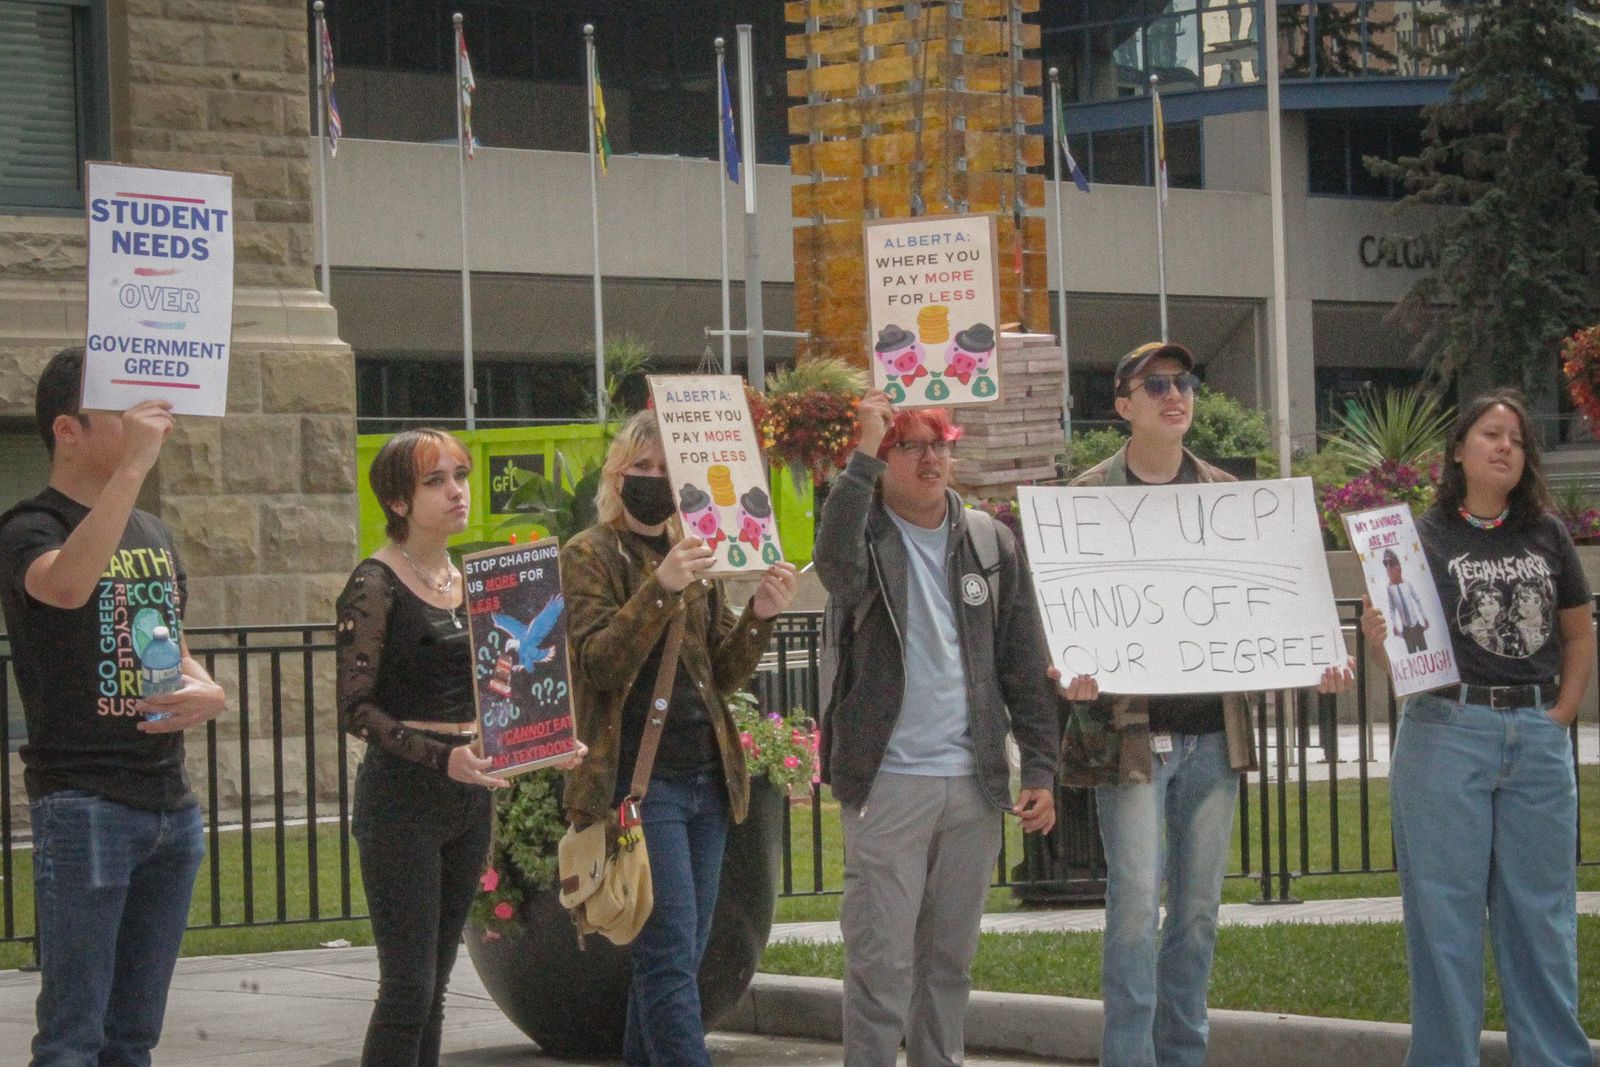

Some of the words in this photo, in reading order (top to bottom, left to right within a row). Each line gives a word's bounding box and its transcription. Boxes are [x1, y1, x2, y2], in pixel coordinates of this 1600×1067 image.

[90, 198, 228, 232] STUDENT
[112, 230, 209, 261] NEEDS
[884, 232, 970, 249] ALBERTA:
[876, 253, 939, 269] WHERE
[945, 250, 980, 263] YOU
[883, 274, 919, 287] PAY
[925, 270, 974, 284] MORE
[119, 284, 200, 313] OVER
[888, 293, 924, 306] FOR
[929, 289, 976, 303] LESS
[89, 334, 225, 360] GOVERNMENT
[124, 358, 189, 377] GREED
[666, 390, 731, 403] ALBERTA:
[663, 410, 712, 423] WHERE
[715, 410, 742, 422] YOU
[672, 431, 700, 443] PAY
[704, 430, 742, 442] MORE
[680, 452, 709, 464] FOR
[712, 450, 747, 463] LESS
[493, 475, 518, 492] GFL
[1032, 493, 1149, 556] HEY
[1175, 487, 1296, 546] UCP!
[1355, 521, 1368, 534] MY
[1369, 513, 1403, 530] SAVINGS
[1369, 534, 1382, 547] ARE
[1383, 531, 1398, 544] NOT
[466, 558, 496, 575] STOP
[499, 546, 558, 568] CHARGING
[126, 581, 165, 606] ECO
[468, 579, 484, 594] US
[486, 573, 518, 591] MORE
[519, 568, 544, 583] FOR
[99, 581, 116, 653] GREEN
[470, 596, 501, 613] LESS
[1039, 583, 1164, 633] HANDS
[1182, 584, 1271, 627] OFF
[114, 583, 134, 668] RECYCLE
[1062, 642, 1149, 677] OUR
[1178, 629, 1343, 674] DEGREE!
[99, 659, 118, 697] GO
[505, 720, 551, 743] CANNOT
[553, 714, 572, 730] EAT
